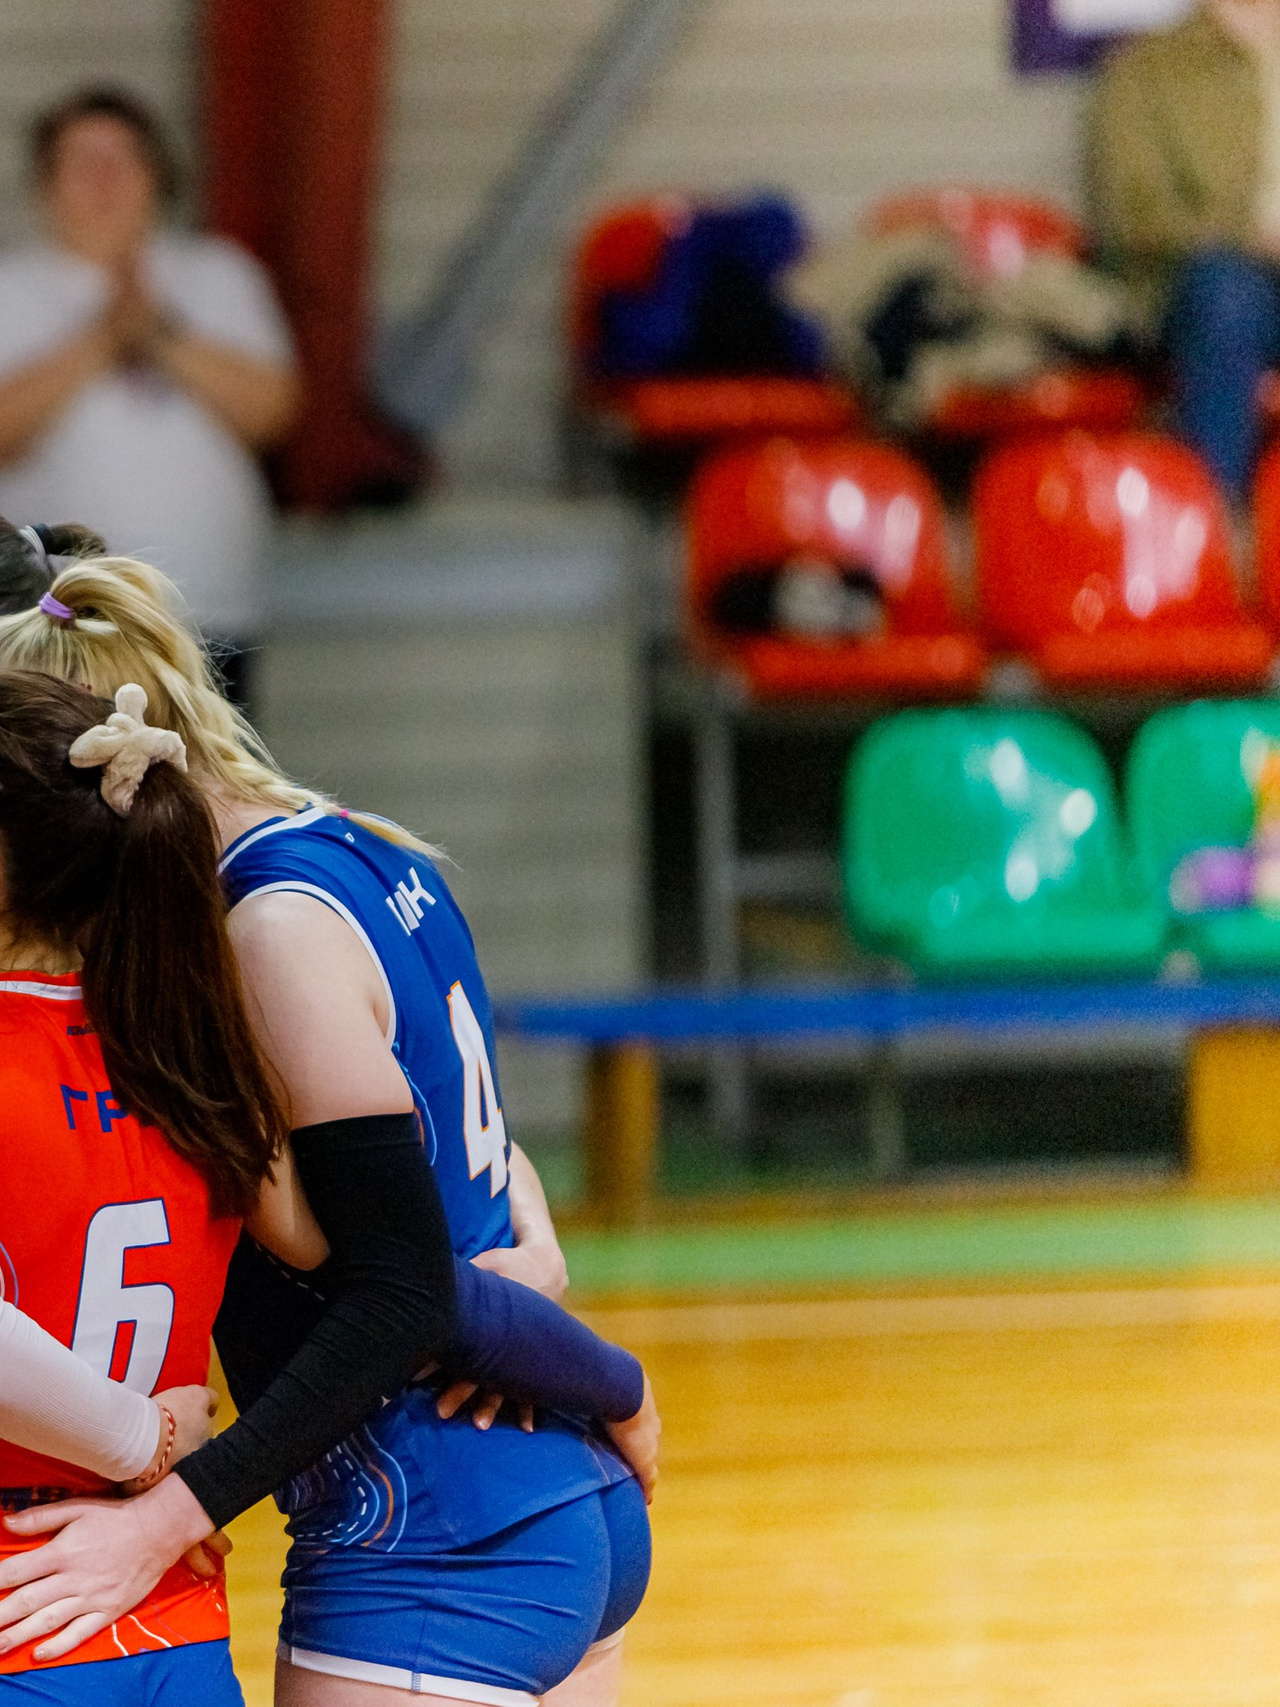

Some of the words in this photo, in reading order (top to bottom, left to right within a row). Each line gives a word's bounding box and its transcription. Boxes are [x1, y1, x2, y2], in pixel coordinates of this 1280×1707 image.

[60, 1084, 130, 1133] ГР
[446, 980, 508, 1199] 4
[71, 1197, 175, 1398] 6
